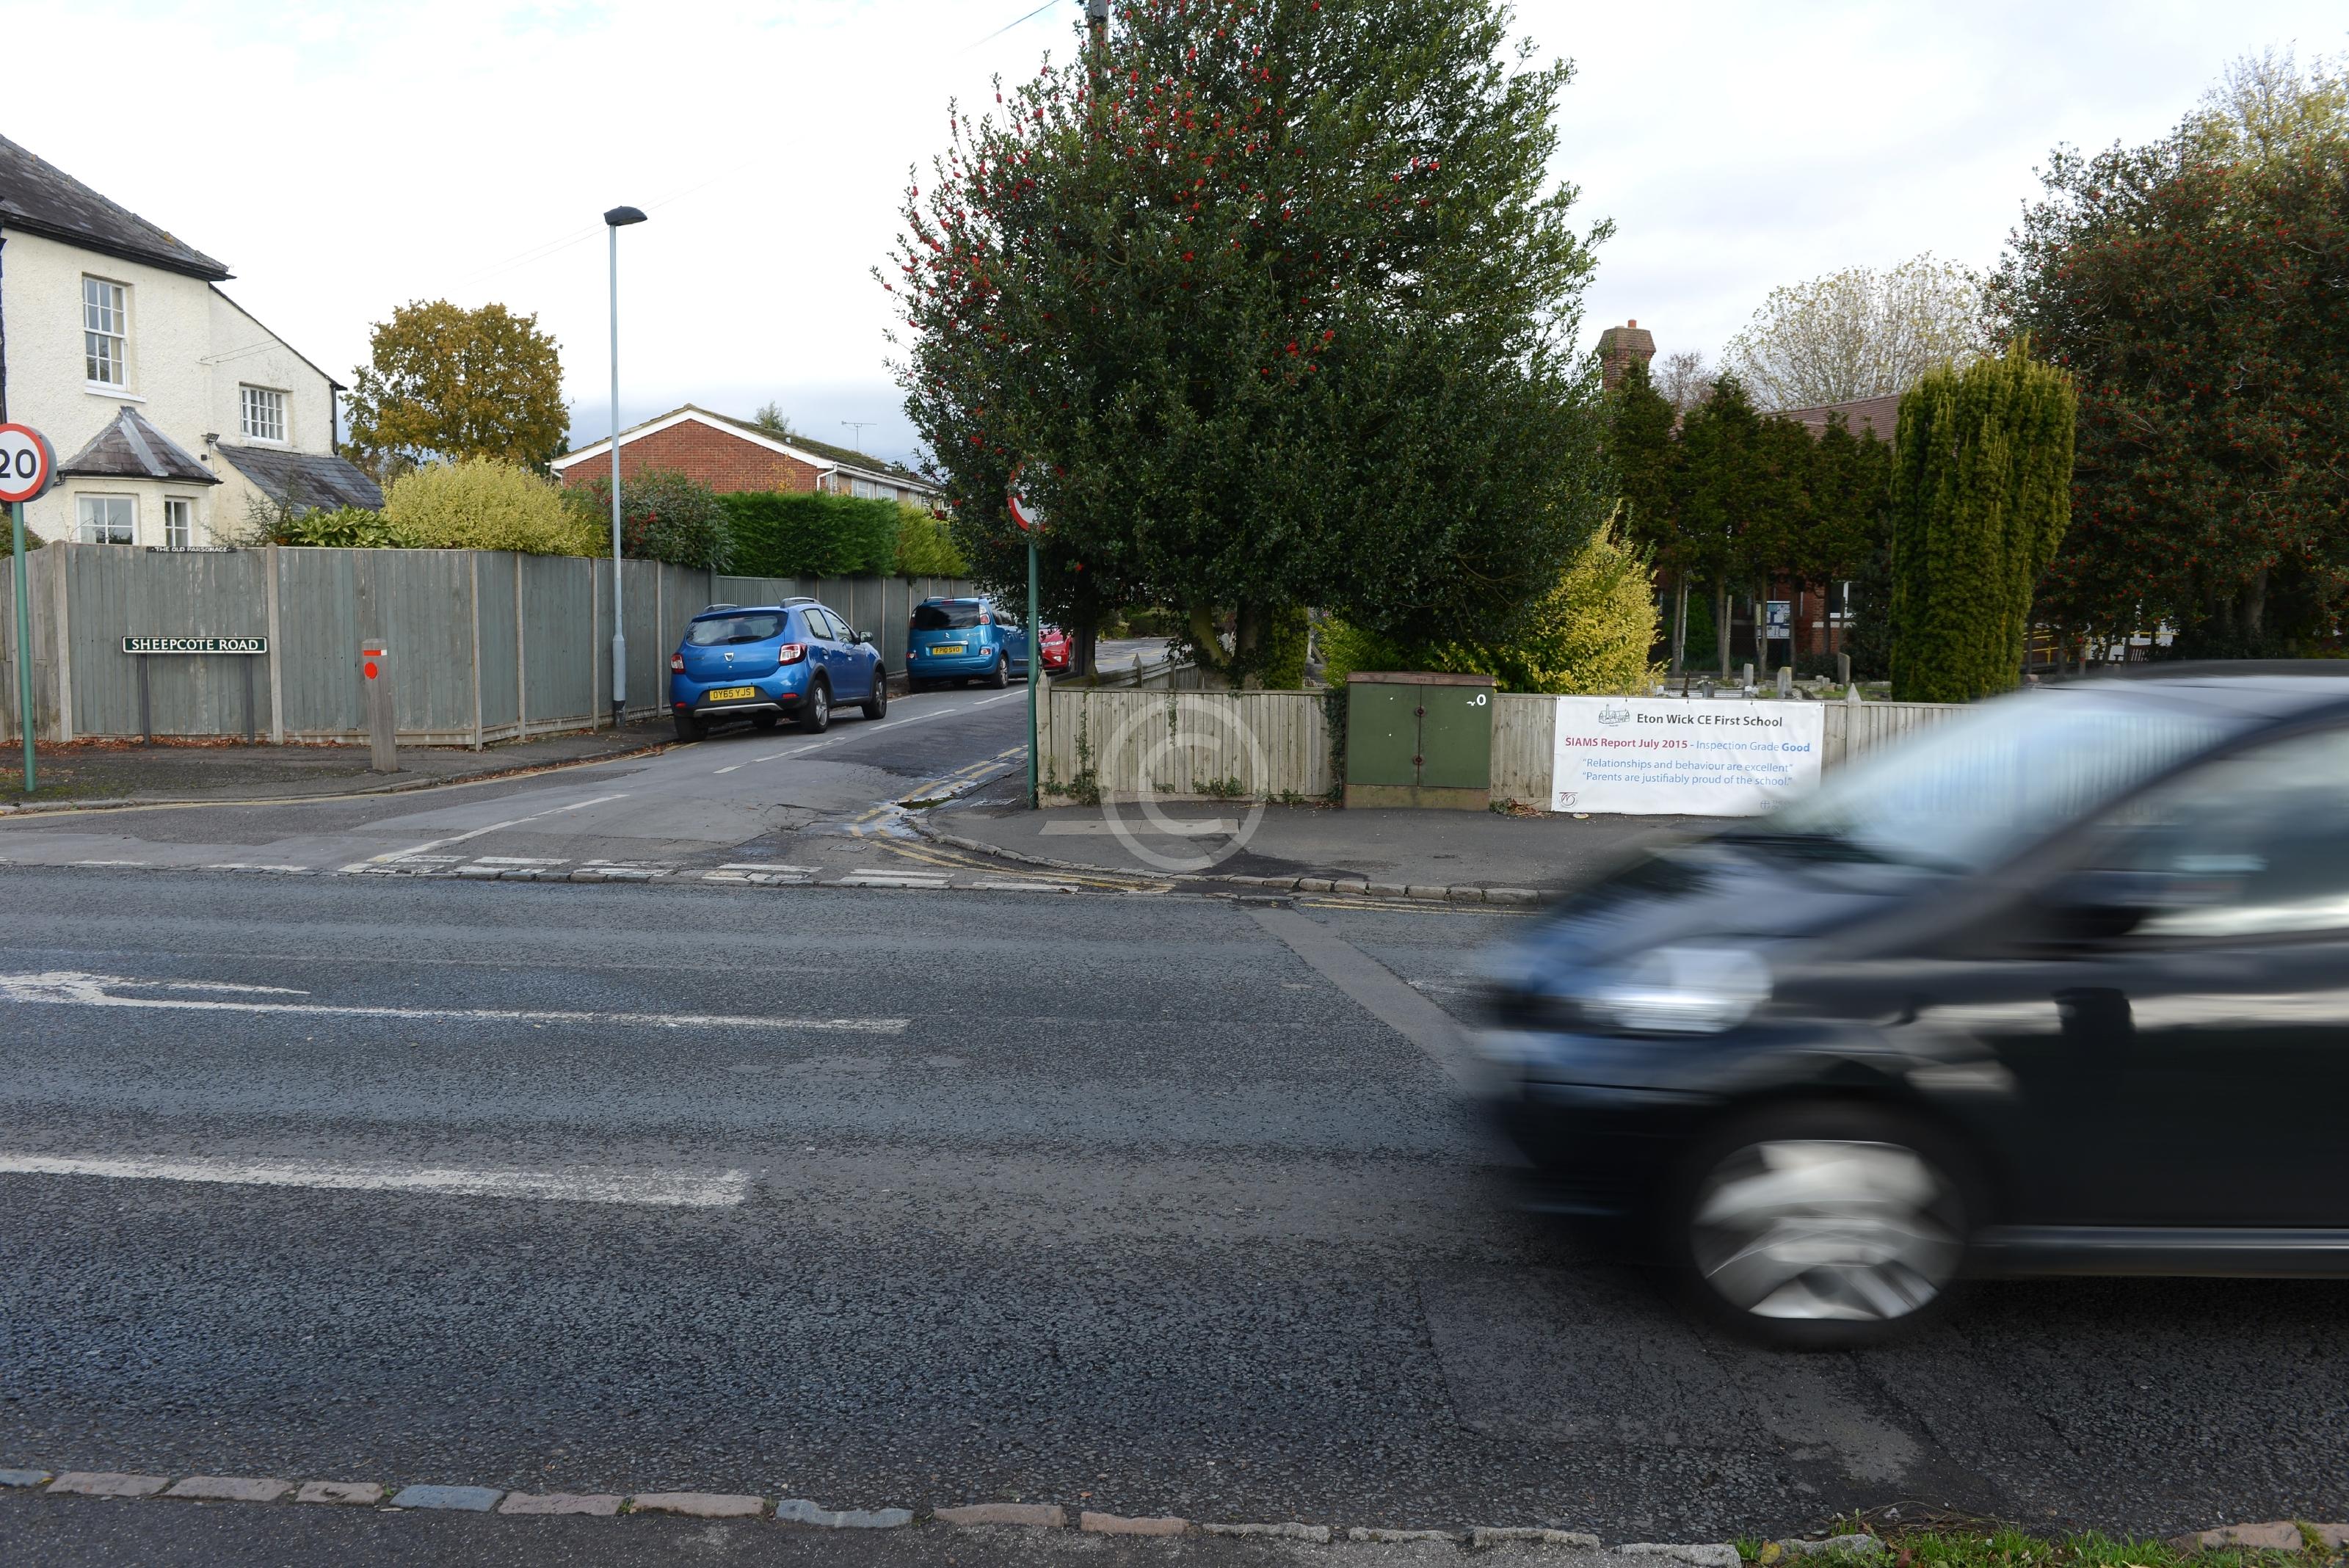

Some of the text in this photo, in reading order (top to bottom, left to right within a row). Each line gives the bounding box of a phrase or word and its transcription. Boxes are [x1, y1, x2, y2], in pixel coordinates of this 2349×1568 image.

[131, 639, 258, 650] SHEEPCOTE ROAD
[713, 688, 751, 699] OY65 YJS
[1636, 713, 1782, 727] Eton Wick CE First School
[1565, 737, 1598, 747] SIAMS
[1601, 738, 1636, 749] Report
[1638, 738, 1659, 750] July
[1662, 740, 1688, 748] 2015
[1696, 740, 1747, 752] Inspection
[1749, 741, 1779, 751] Grade
[1782, 742, 1810, 752] Good
[1654, 760, 1672, 769] and
[1675, 761, 1725, 771] behaviour
[1641, 773, 1689, 785] justifiably
[1692, 775, 1721, 785] proud
[1724, 775, 1734, 784] of
[1737, 776, 1752, 785] the
